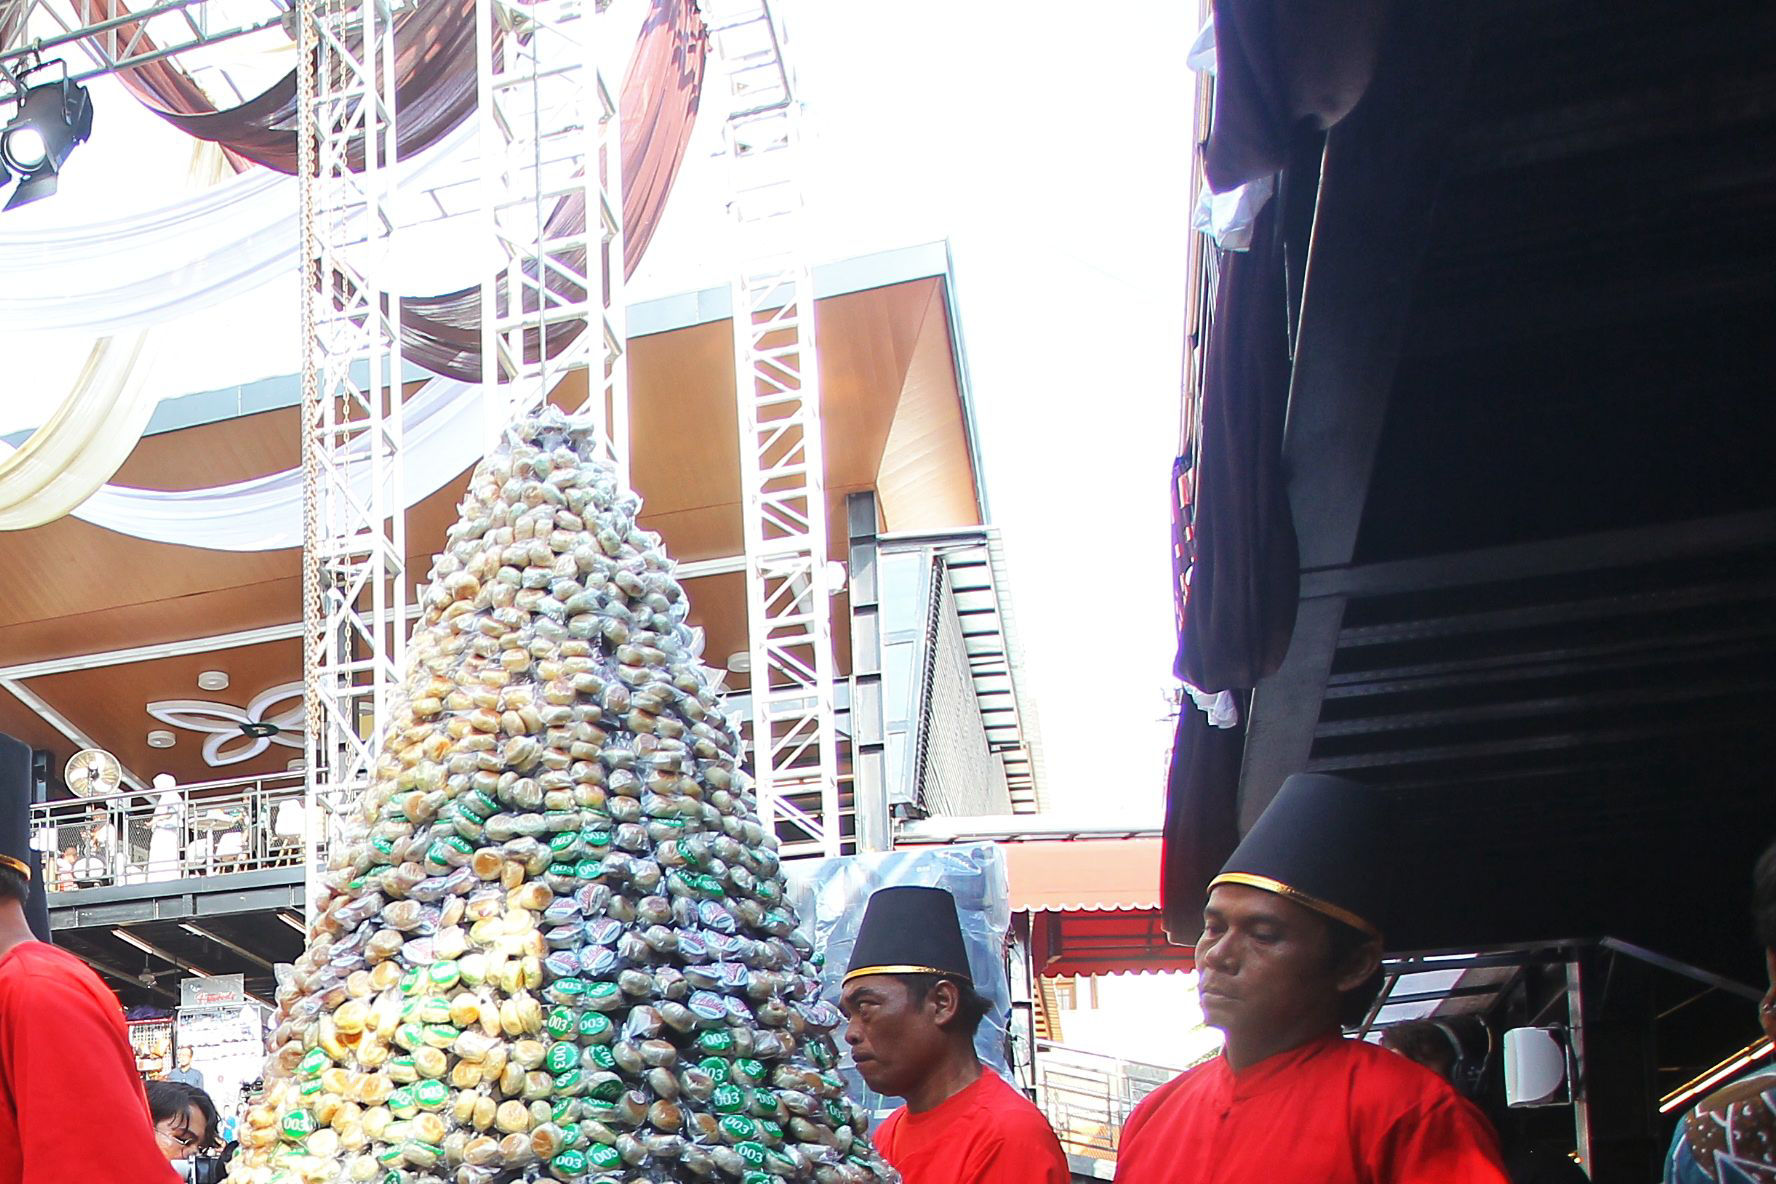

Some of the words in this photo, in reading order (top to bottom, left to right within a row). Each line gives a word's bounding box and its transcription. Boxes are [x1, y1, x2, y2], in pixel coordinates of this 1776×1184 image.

[551, 835, 573, 847] 003
[584, 831, 608, 841] 003
[552, 865, 573, 874] 003
[556, 981, 582, 990] 003
[548, 1015, 567, 1030] 003
[581, 1017, 605, 1029] 003
[705, 1032, 730, 1044] 003
[554, 1046, 566, 1068] 003
[596, 1044, 615, 1067] 003
[715, 1093, 740, 1107] 003
[725, 1118, 750, 1134] 003
[593, 1150, 618, 1163] 003
[739, 1145, 763, 1163] 003
[556, 1156, 582, 1169] 003
